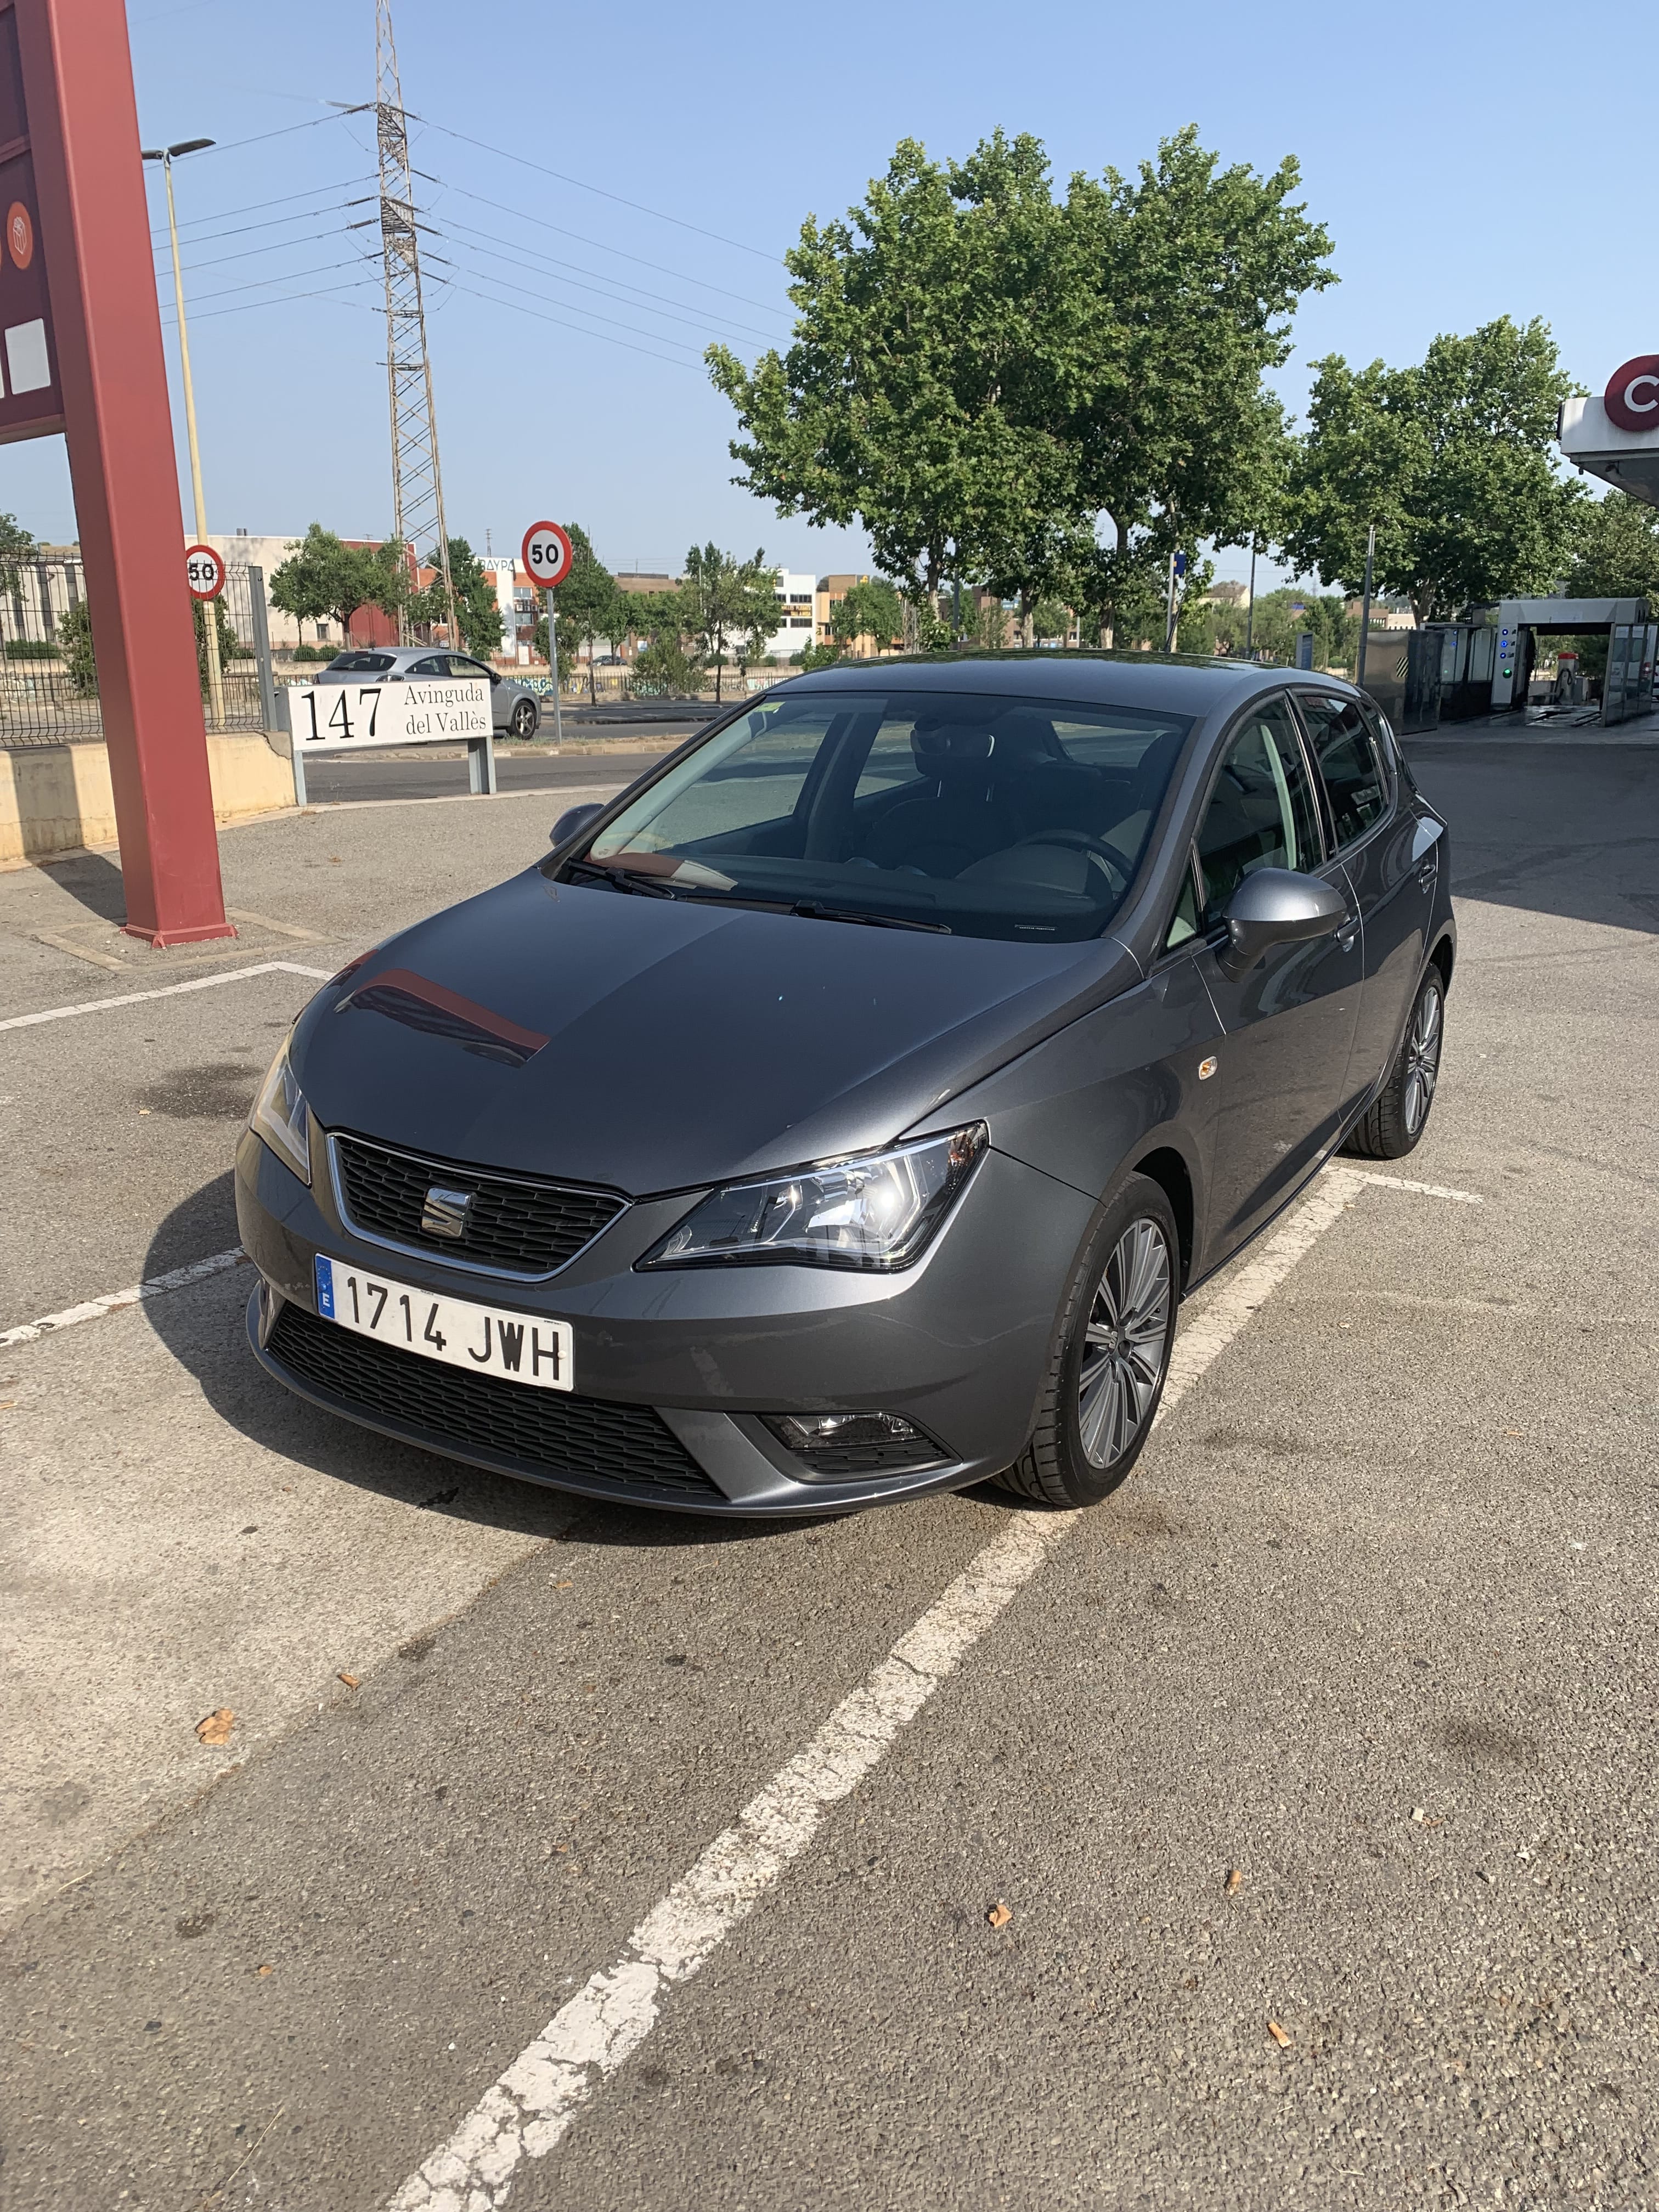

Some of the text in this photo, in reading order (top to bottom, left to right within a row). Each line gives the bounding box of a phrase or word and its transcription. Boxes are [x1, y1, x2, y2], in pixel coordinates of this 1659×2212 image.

[532, 544, 558, 564] 50
[189, 563, 214, 580] 50
[404, 682, 484, 707] Avinguda
[301, 688, 381, 740] 147
[406, 711, 486, 735] del Vallès
[323, 1293, 330, 1308] E
[347, 1277, 560, 1381] 1714 JWH
